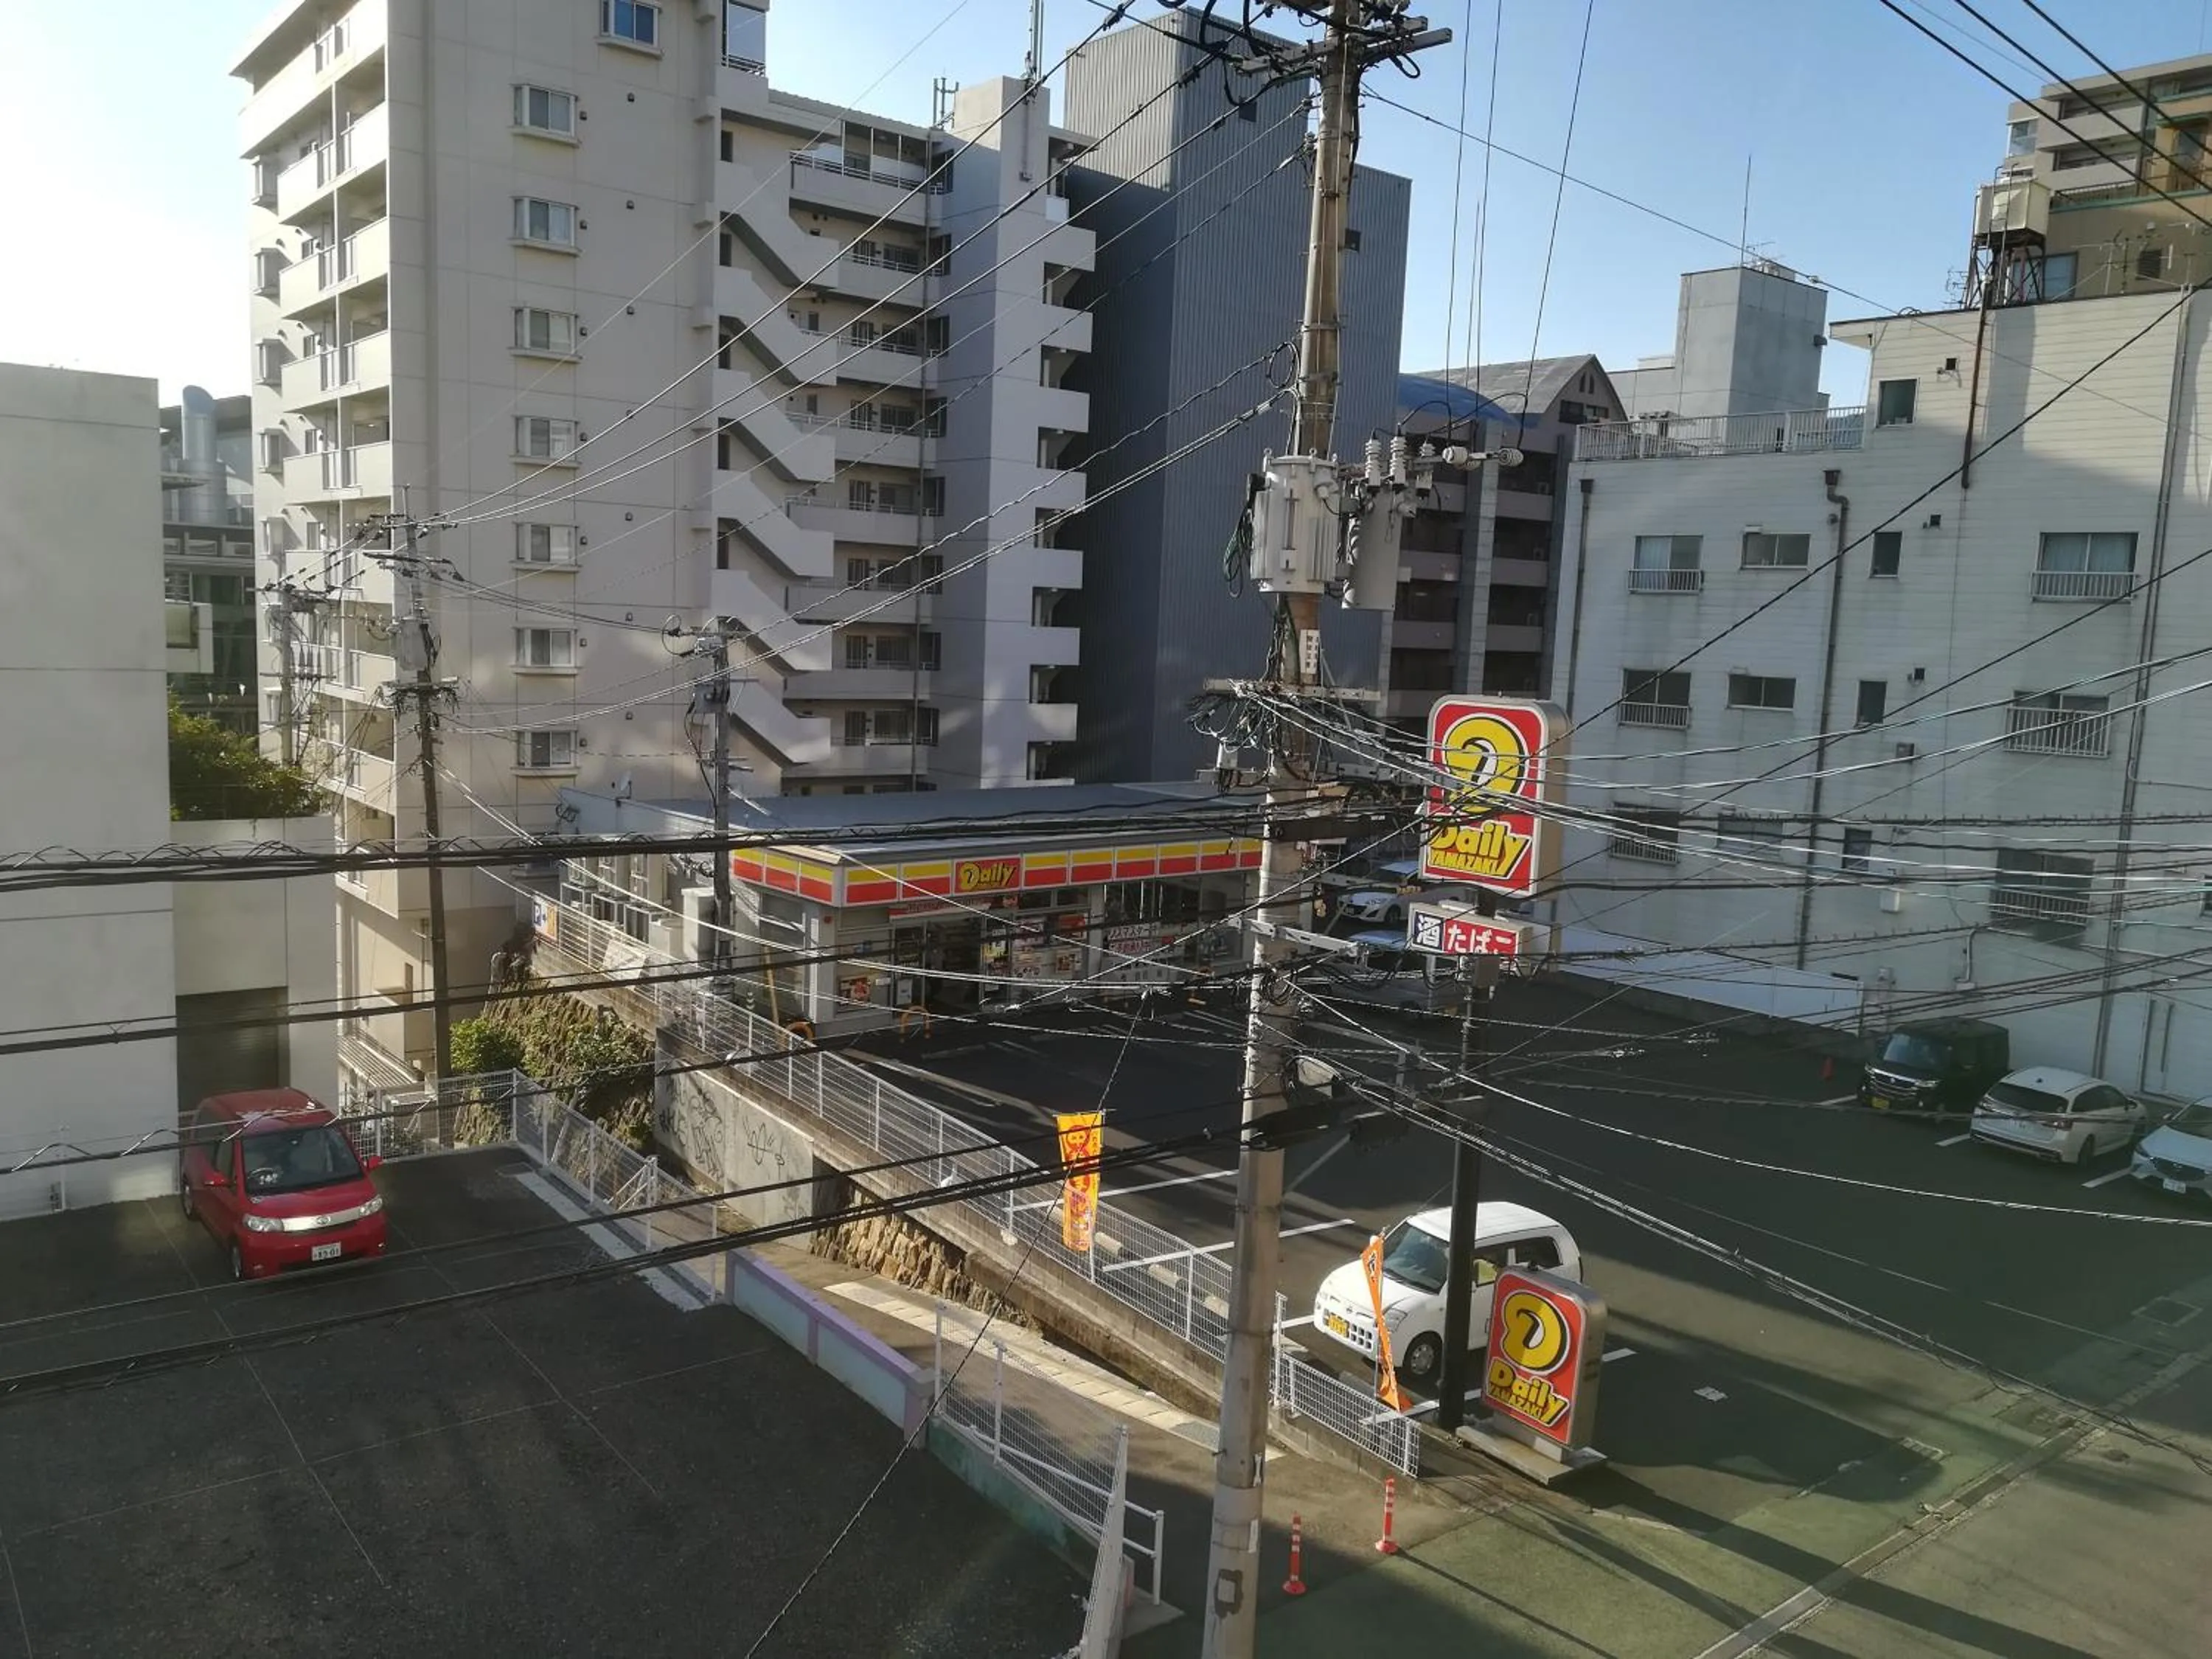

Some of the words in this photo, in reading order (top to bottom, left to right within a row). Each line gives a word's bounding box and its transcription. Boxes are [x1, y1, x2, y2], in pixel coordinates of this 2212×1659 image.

[1430, 821, 1527, 877] Daily
[1430, 849, 1498, 874] YAMAZAKI
[961, 862, 1015, 890] Daily
[1416, 914, 1441, 947] 酒
[1488, 1383, 1543, 1420] YAMAZAKI
[1490, 1360, 1567, 1424] Daily
